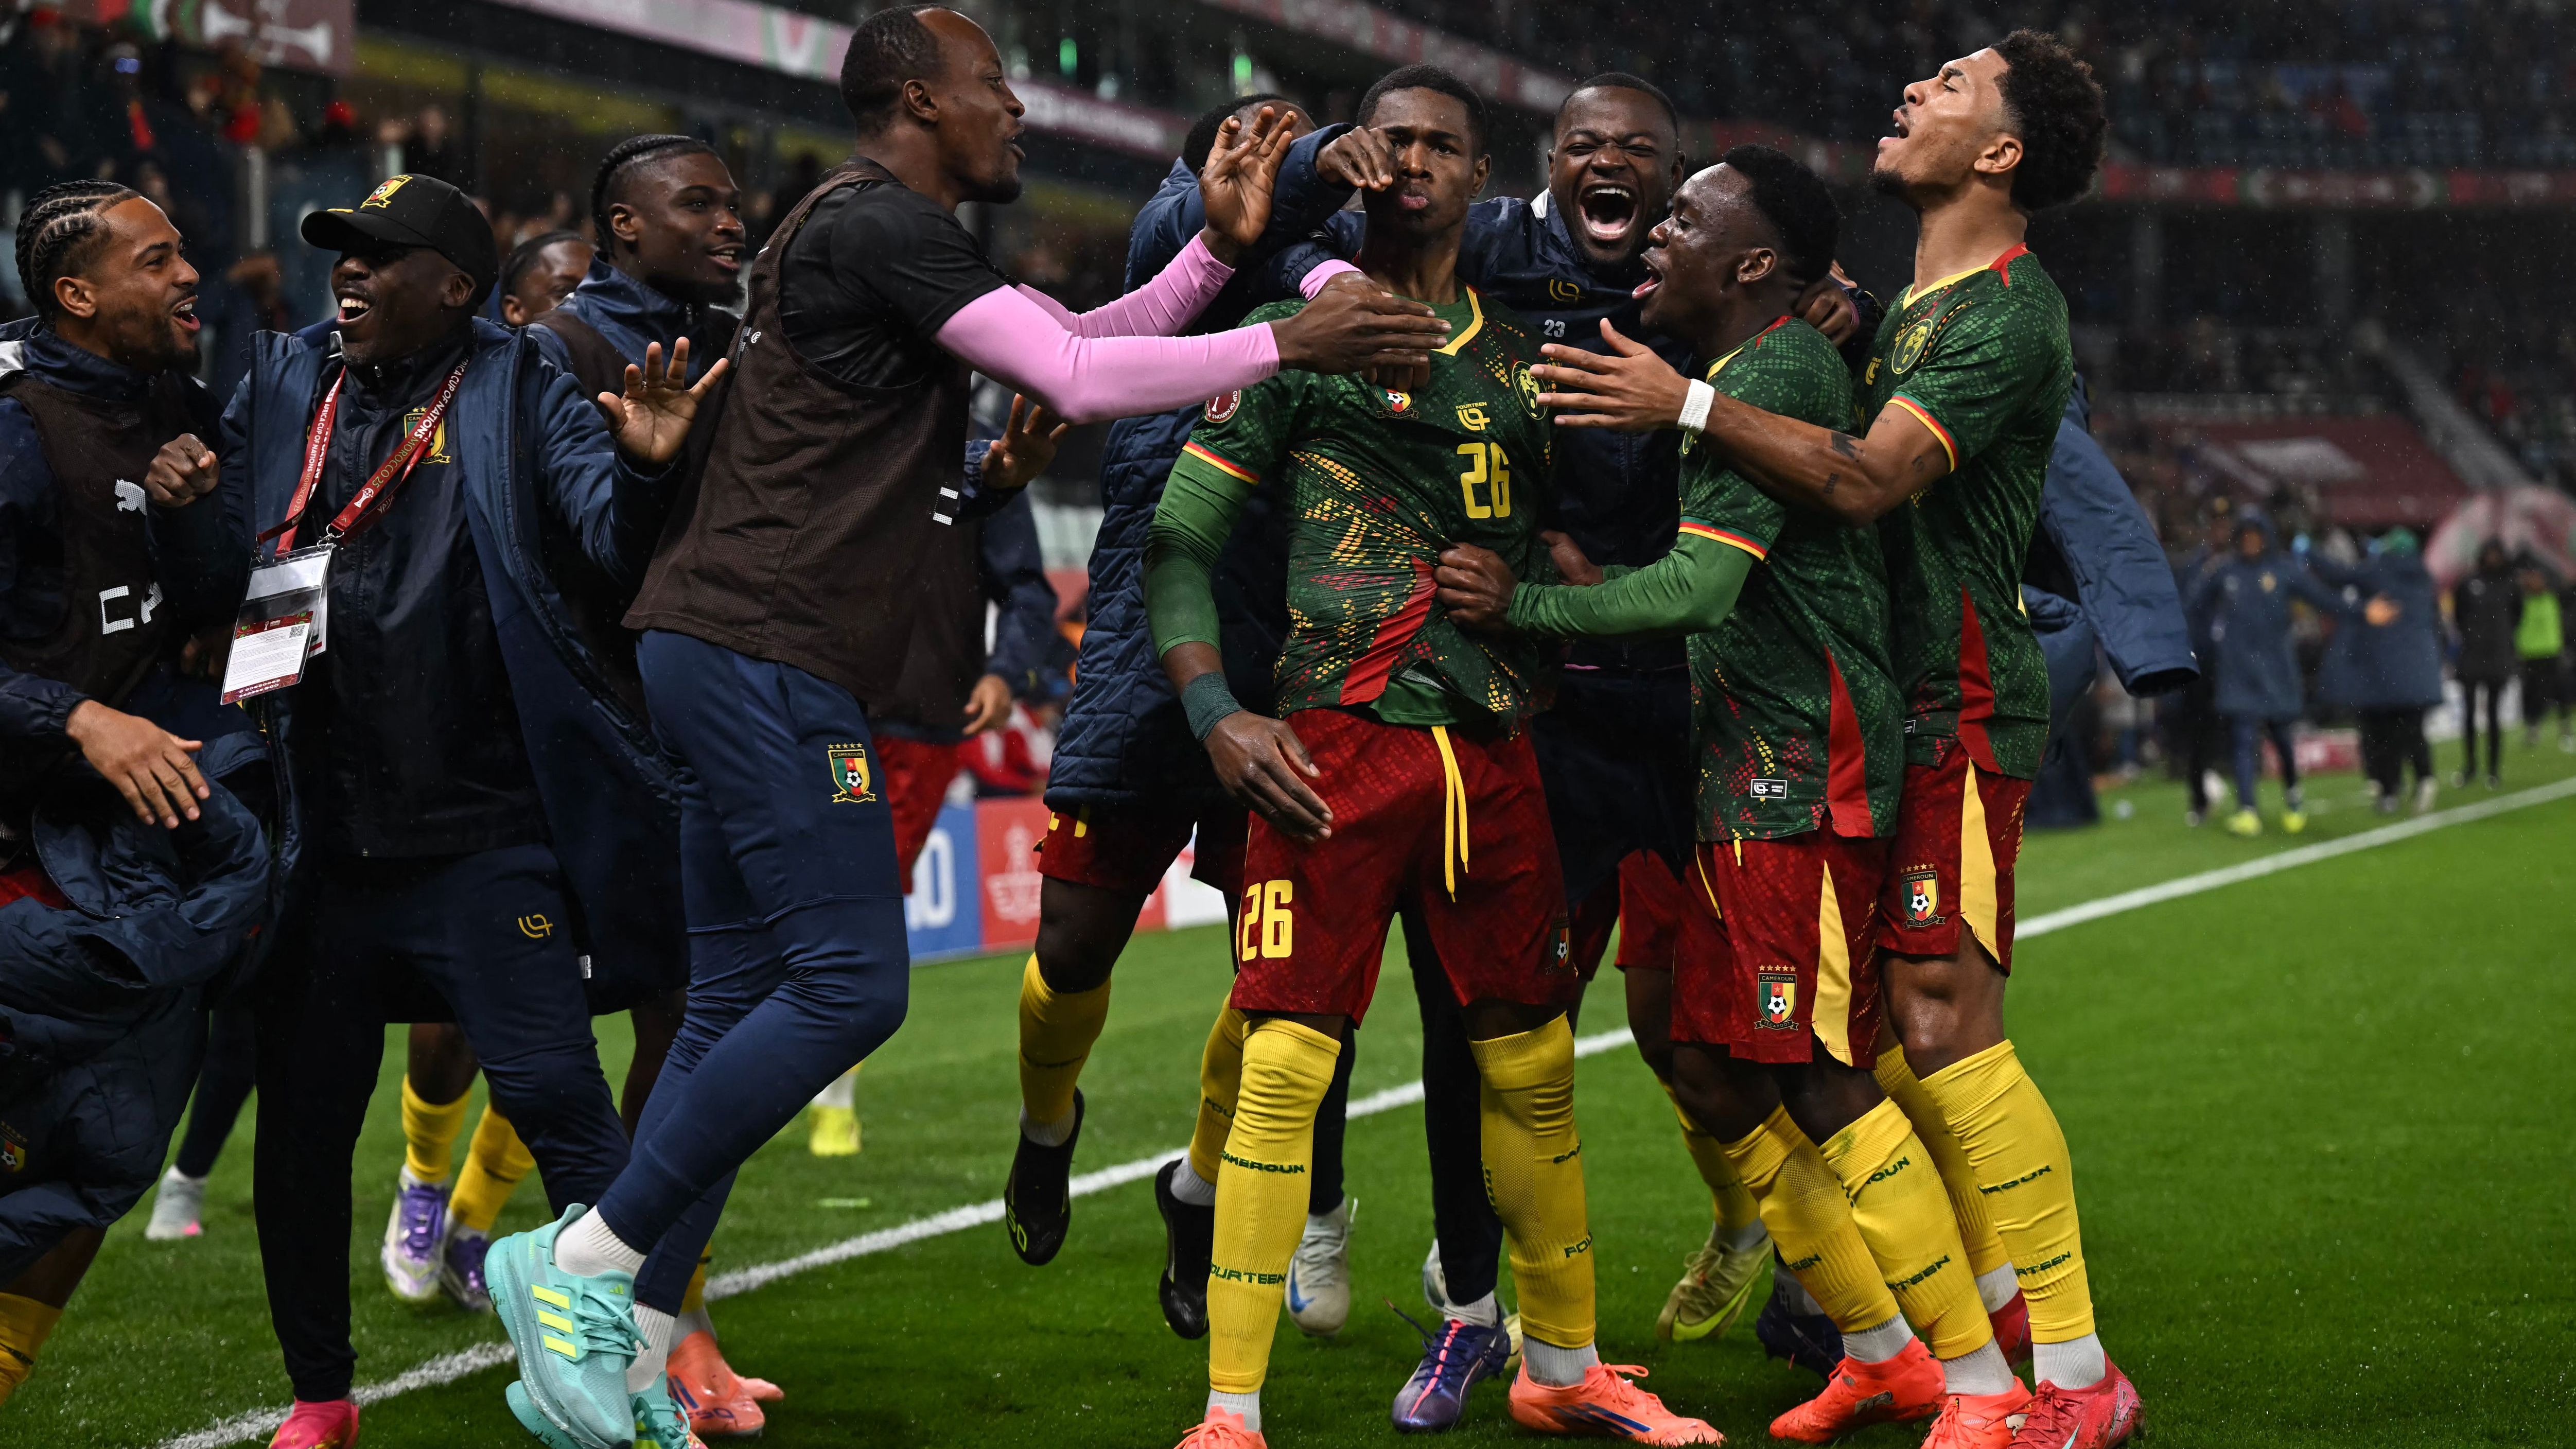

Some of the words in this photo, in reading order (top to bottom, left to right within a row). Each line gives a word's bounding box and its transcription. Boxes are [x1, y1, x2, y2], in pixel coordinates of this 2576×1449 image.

[1544, 319, 1566, 338] 23
[448, 375, 460, 392] CUP
[442, 390, 451, 404] OF
[1455, 401, 1487, 410] FOURTEEN
[320, 403, 330, 422] AFRICA
[1212, 409, 1231, 419] NATIONS
[1229, 403, 1235, 411] OF
[414, 400, 445, 439] NATIONS
[314, 434, 321, 444] OF
[307, 444, 318, 473] NATIONS
[381, 436, 419, 478] MOROCCO
[372, 476, 384, 488] 25
[1457, 442, 1511, 519] 26
[1903, 874, 1933, 882] CAMEROUN
[1241, 880, 1293, 962] 26
[1909, 917, 1936, 926] FECAFOOT
[1205, 1096, 1236, 1119] FOU
[1210, 1261, 1287, 1285] OURTEEN
[2013, 1250, 2072, 1278] RTEEN
